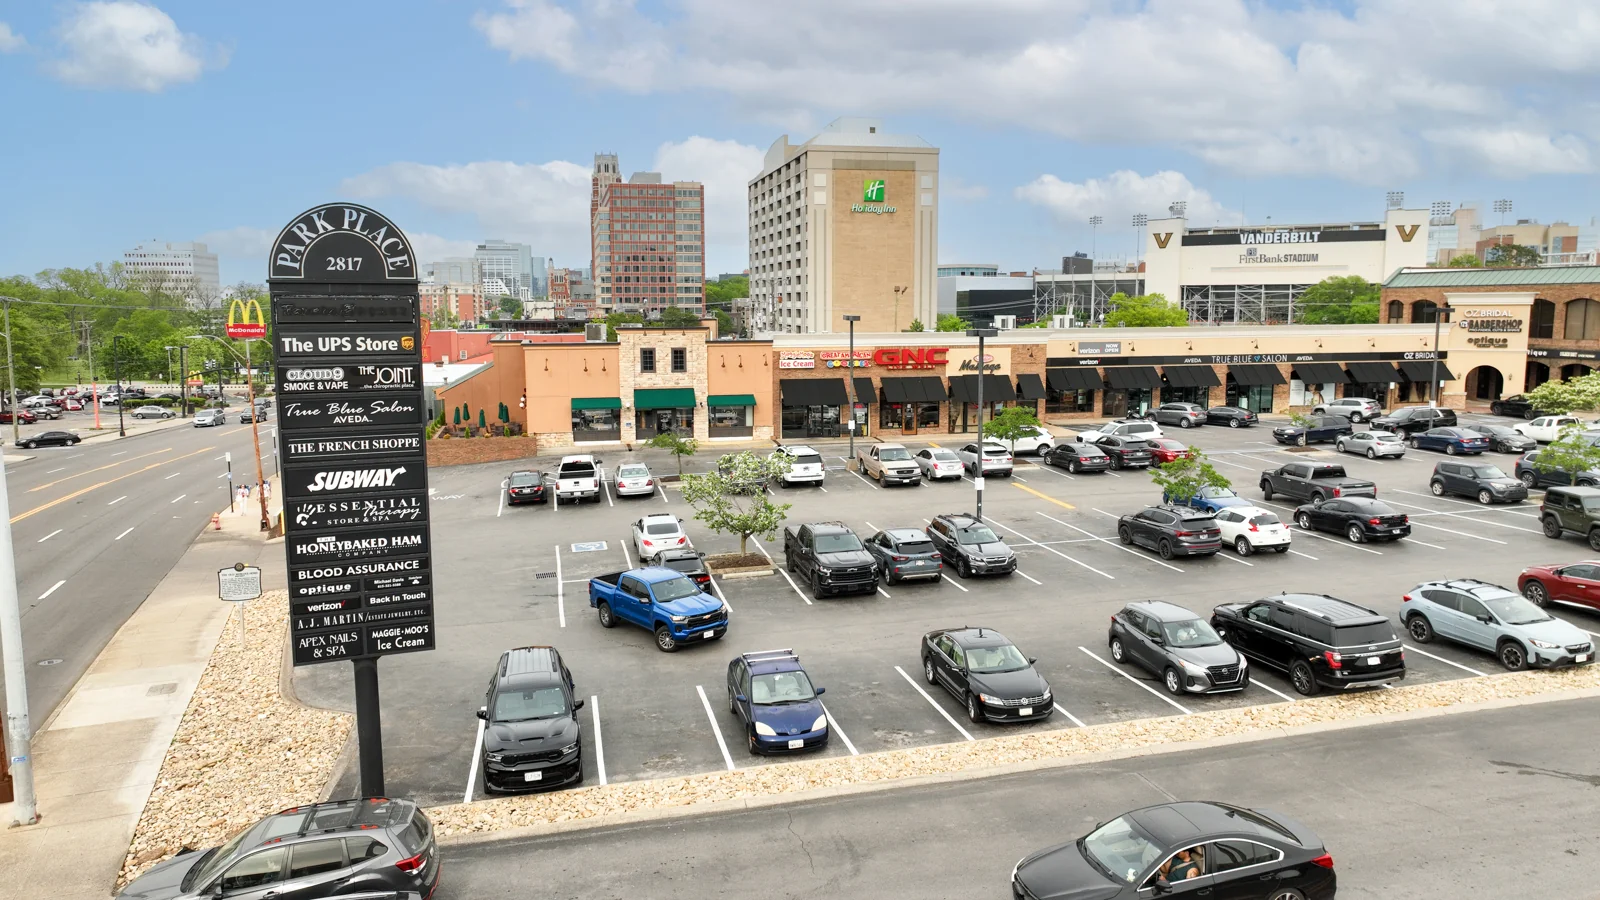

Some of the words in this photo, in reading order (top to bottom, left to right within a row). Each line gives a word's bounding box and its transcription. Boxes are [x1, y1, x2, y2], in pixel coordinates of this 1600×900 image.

[852, 203, 884, 215] Holiday
[884, 204, 897, 212] Inn
[276, 209, 336, 270] PARK
[342, 208, 410, 270] PLACE
[1240, 230, 1321, 244] VANDERBILT
[326, 257, 363, 271] 2817
[1239, 254, 1283, 263] FirstBank
[1284, 253, 1318, 263] STADIUM
[1469, 320, 1522, 329] BARBERSHOP
[282, 338, 313, 352] The
[318, 337, 351, 352] UPS
[356, 336, 398, 351] Store
[1467, 336, 1508, 345] optique
[874, 348, 949, 364] GNC
[358, 366, 375, 375] THE
[959, 360, 1001, 373] Masage
[284, 382, 316, 391] SMOKE
[317, 382, 324, 390] &
[325, 381, 348, 390] VAPE
[285, 403, 321, 417] True
[326, 403, 364, 414] Blue
[370, 400, 414, 414] Salon
[333, 415, 369, 424] AVEDA
[288, 443, 315, 454] THE
[318, 440, 370, 452] FRENCH
[372, 438, 420, 449] SHOPPE
[307, 466, 406, 492] SUBWAY
[316, 497, 420, 513] ESSENTIAL
[362, 505, 421, 519] Therapy
[296, 538, 387, 554] HONEYBAKED
[392, 535, 422, 545] HAM
[298, 567, 343, 580] BLOOD
[346, 560, 420, 575] ASSURANCE
[300, 583, 351, 595] optique
[370, 596, 390, 604] Back
[402, 592, 426, 601] Touch
[307, 602, 342, 612] verizon
[298, 620, 320, 629] A.J.
[299, 636, 326, 648] APEX
[330, 632, 358, 644] NAILS
[378, 639, 391, 650] Ice
[395, 637, 424, 648] Cream
[313, 648, 323, 658] &
[326, 645, 346, 656] SPA
